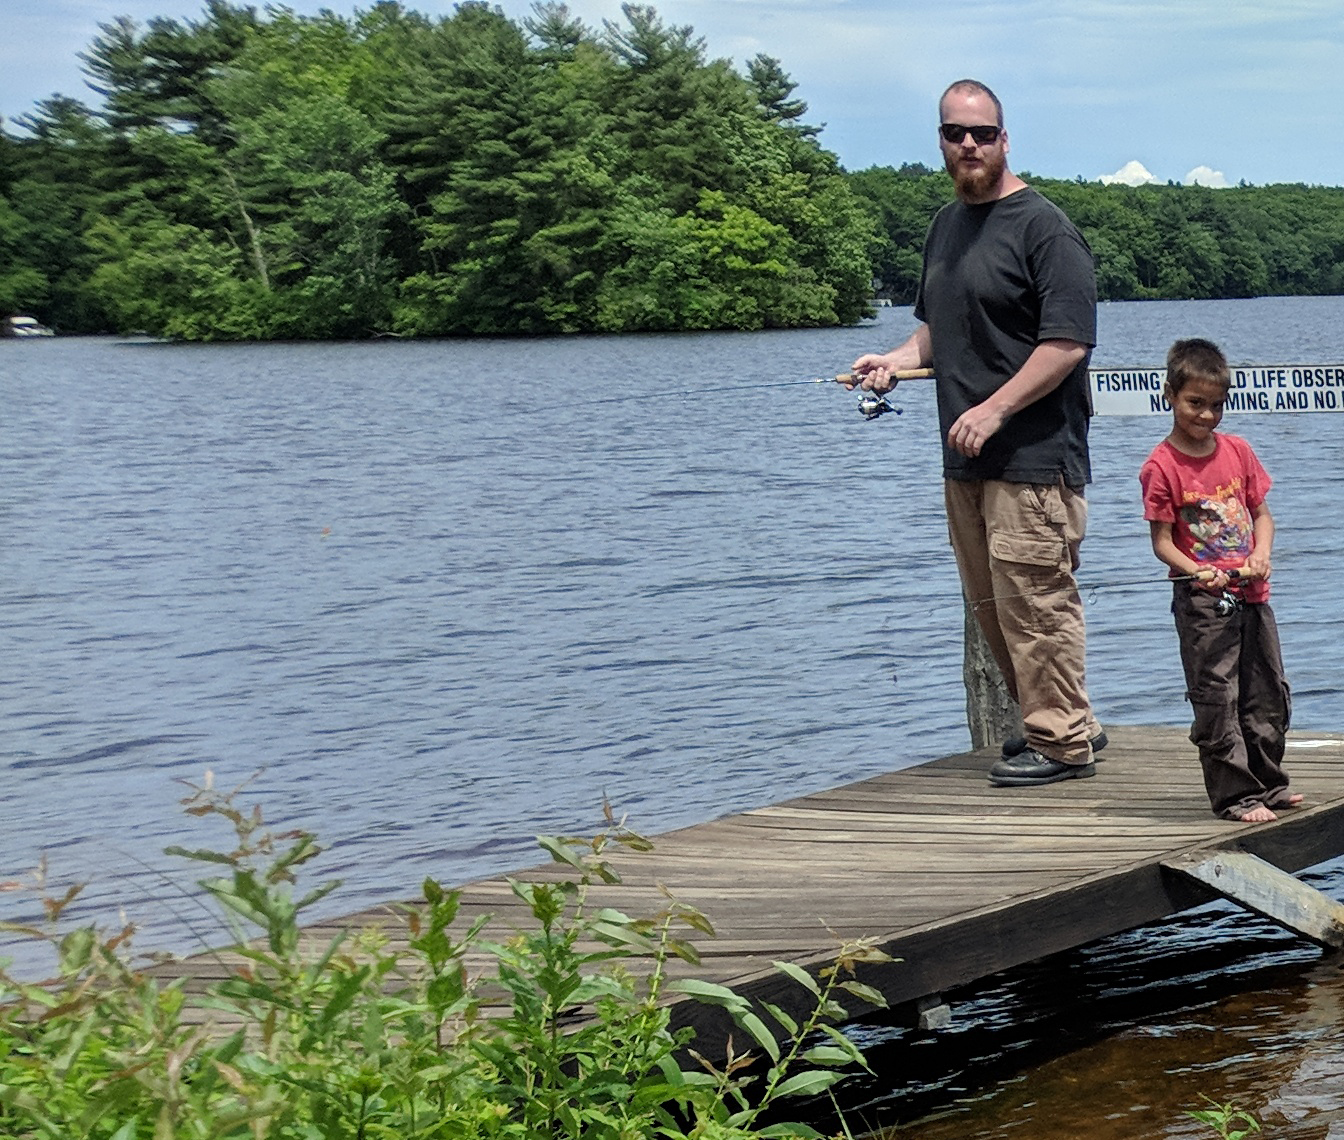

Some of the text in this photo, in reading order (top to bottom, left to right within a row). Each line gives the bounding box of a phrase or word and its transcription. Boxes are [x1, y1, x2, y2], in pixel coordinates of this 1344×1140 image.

[1096, 372, 1161, 392] FISHING
[1252, 369, 1287, 388] LIFE
[1149, 393, 1172, 412] NO
[1225, 391, 1270, 411] MING
[1275, 390, 1309, 410] AND
[1314, 390, 1336, 409] NO
